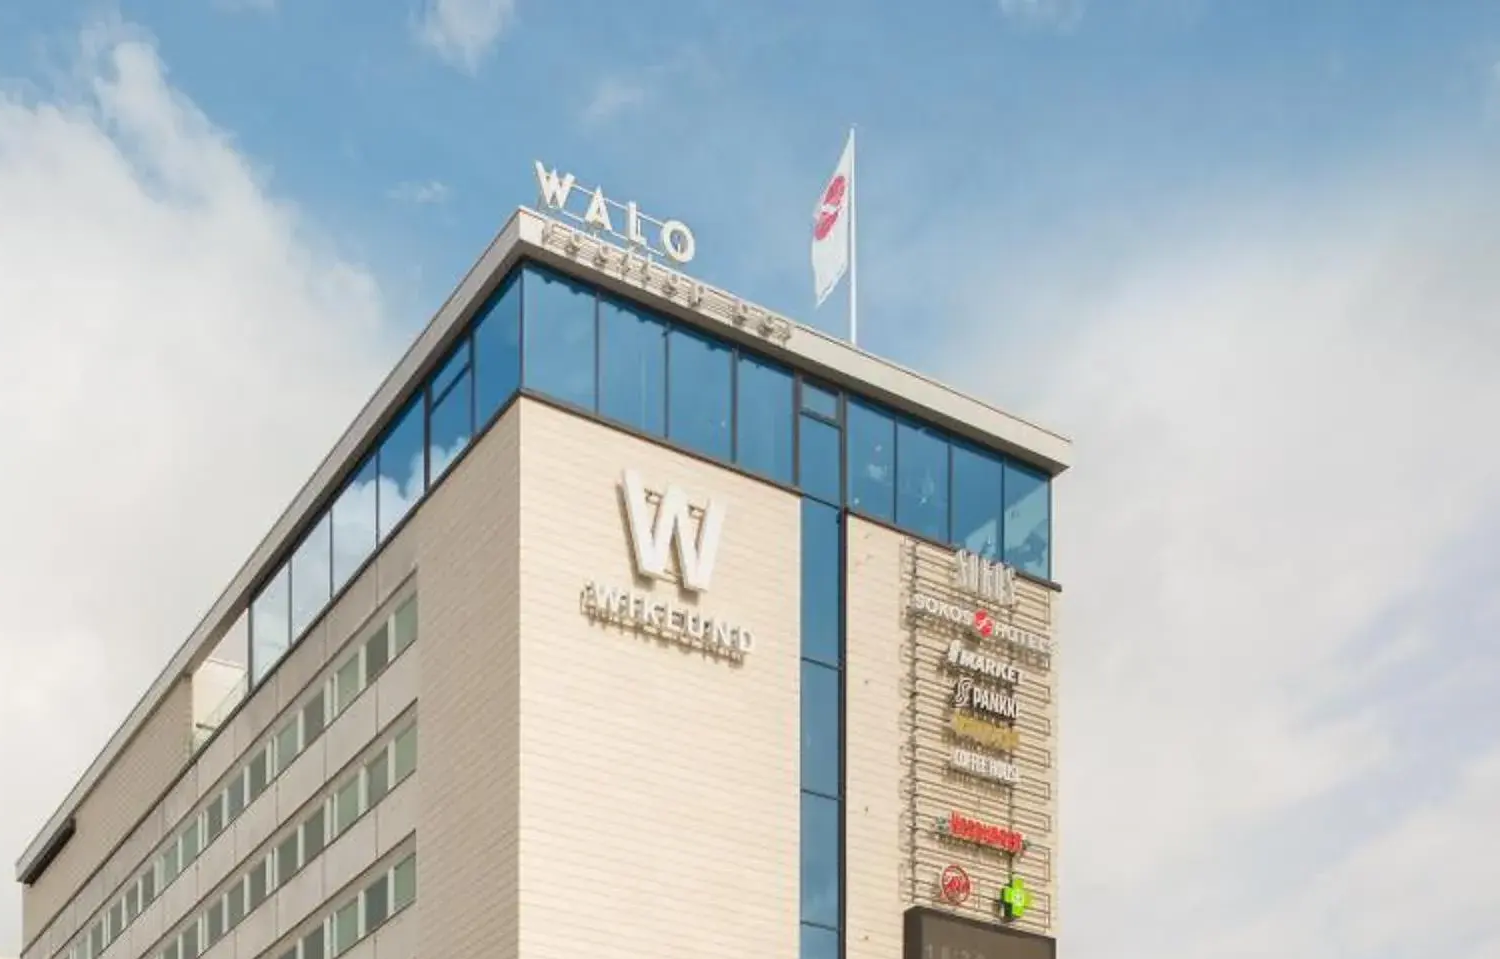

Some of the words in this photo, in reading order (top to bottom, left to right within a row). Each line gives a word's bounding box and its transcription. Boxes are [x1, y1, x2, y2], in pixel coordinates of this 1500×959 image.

[535, 160, 695, 263] WALO
[619, 468, 728, 594] W
[913, 592, 972, 625] SOKOS
